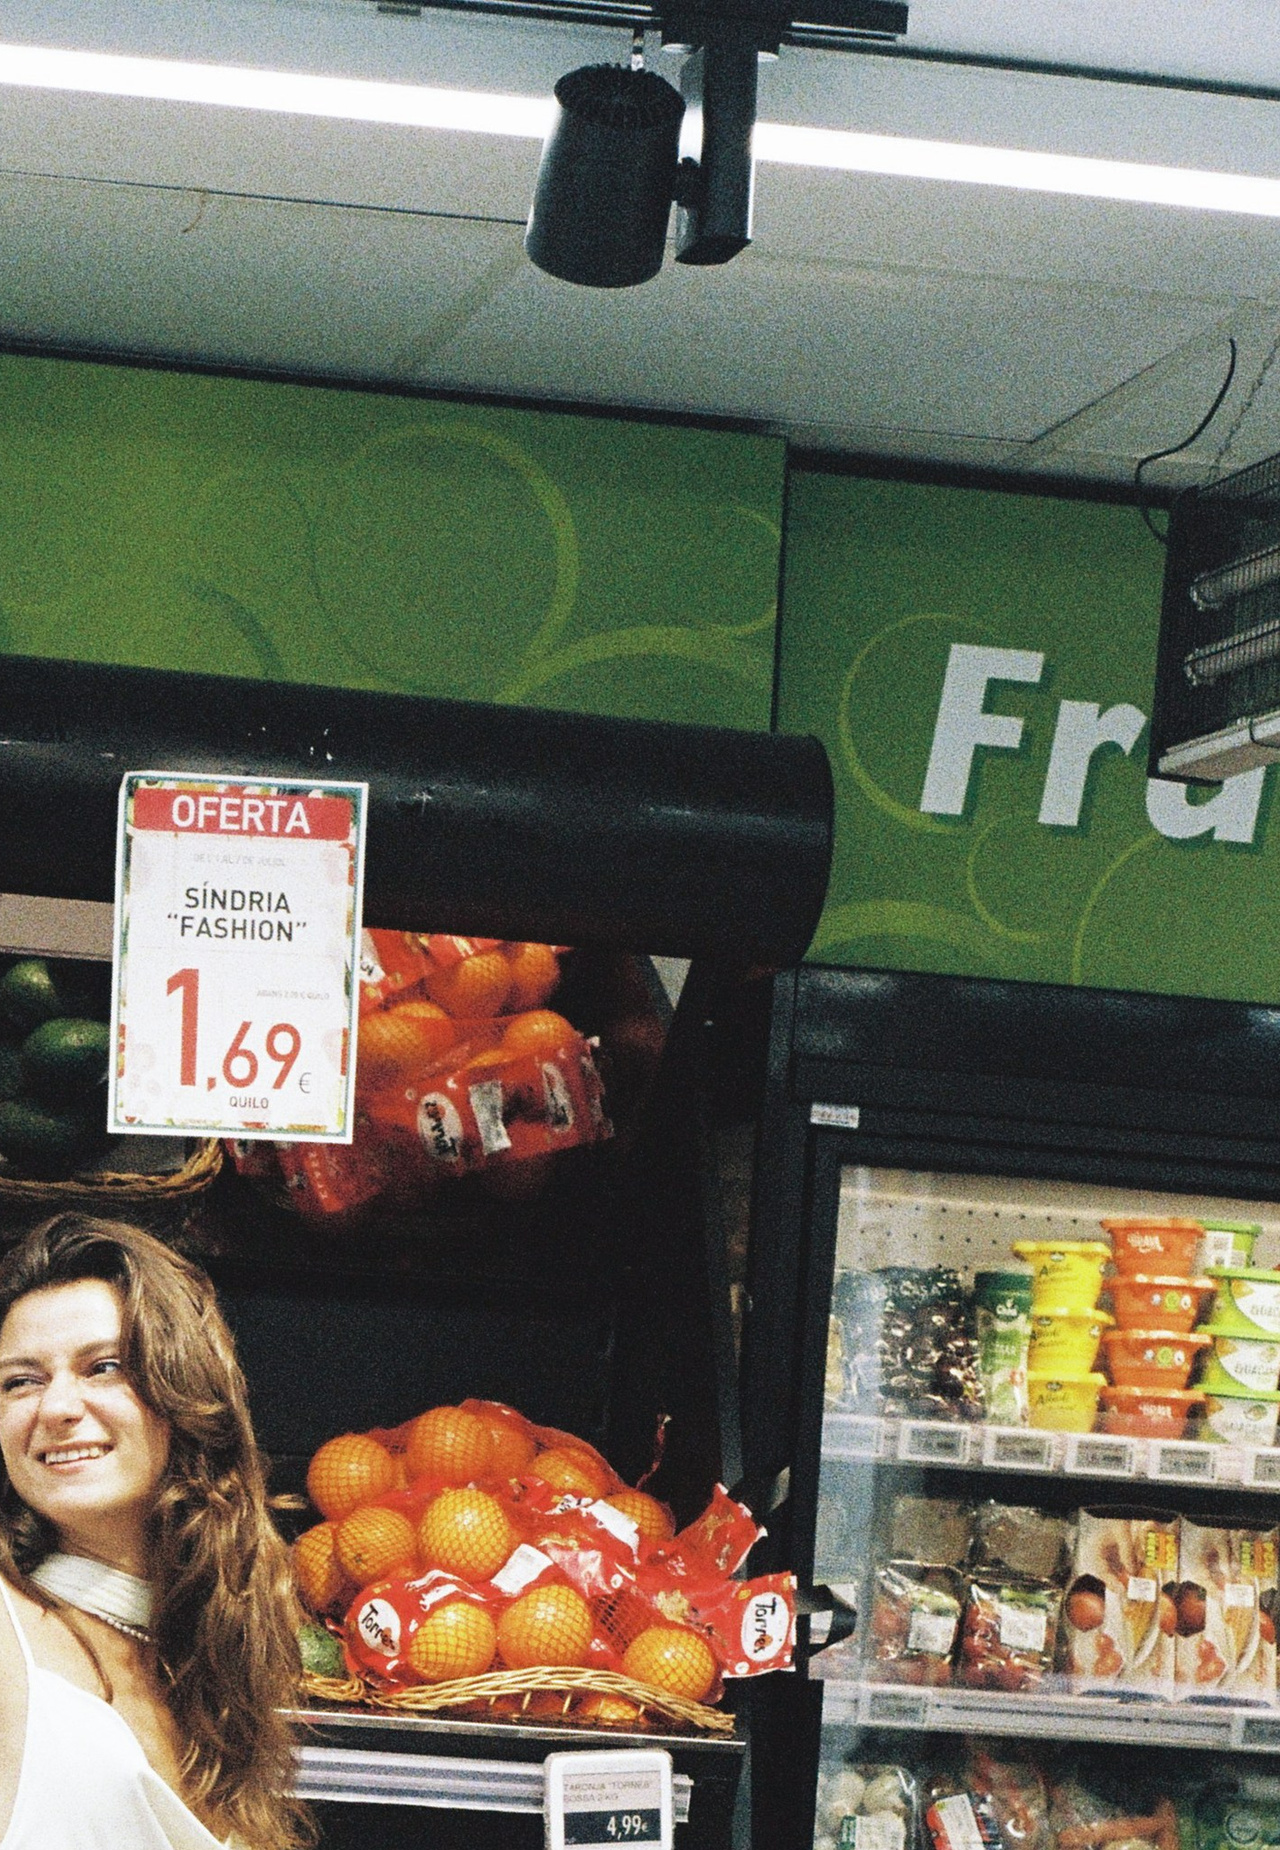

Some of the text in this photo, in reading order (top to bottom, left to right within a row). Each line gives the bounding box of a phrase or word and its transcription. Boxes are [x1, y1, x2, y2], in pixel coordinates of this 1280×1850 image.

[171, 794, 311, 834] OFERTA
[184, 881, 291, 914] SÍNDRIA
[229, 1095, 269, 1109] QUILO
[753, 1596, 778, 1654] Torres
[606, 1814, 648, 1840] 4,99€
